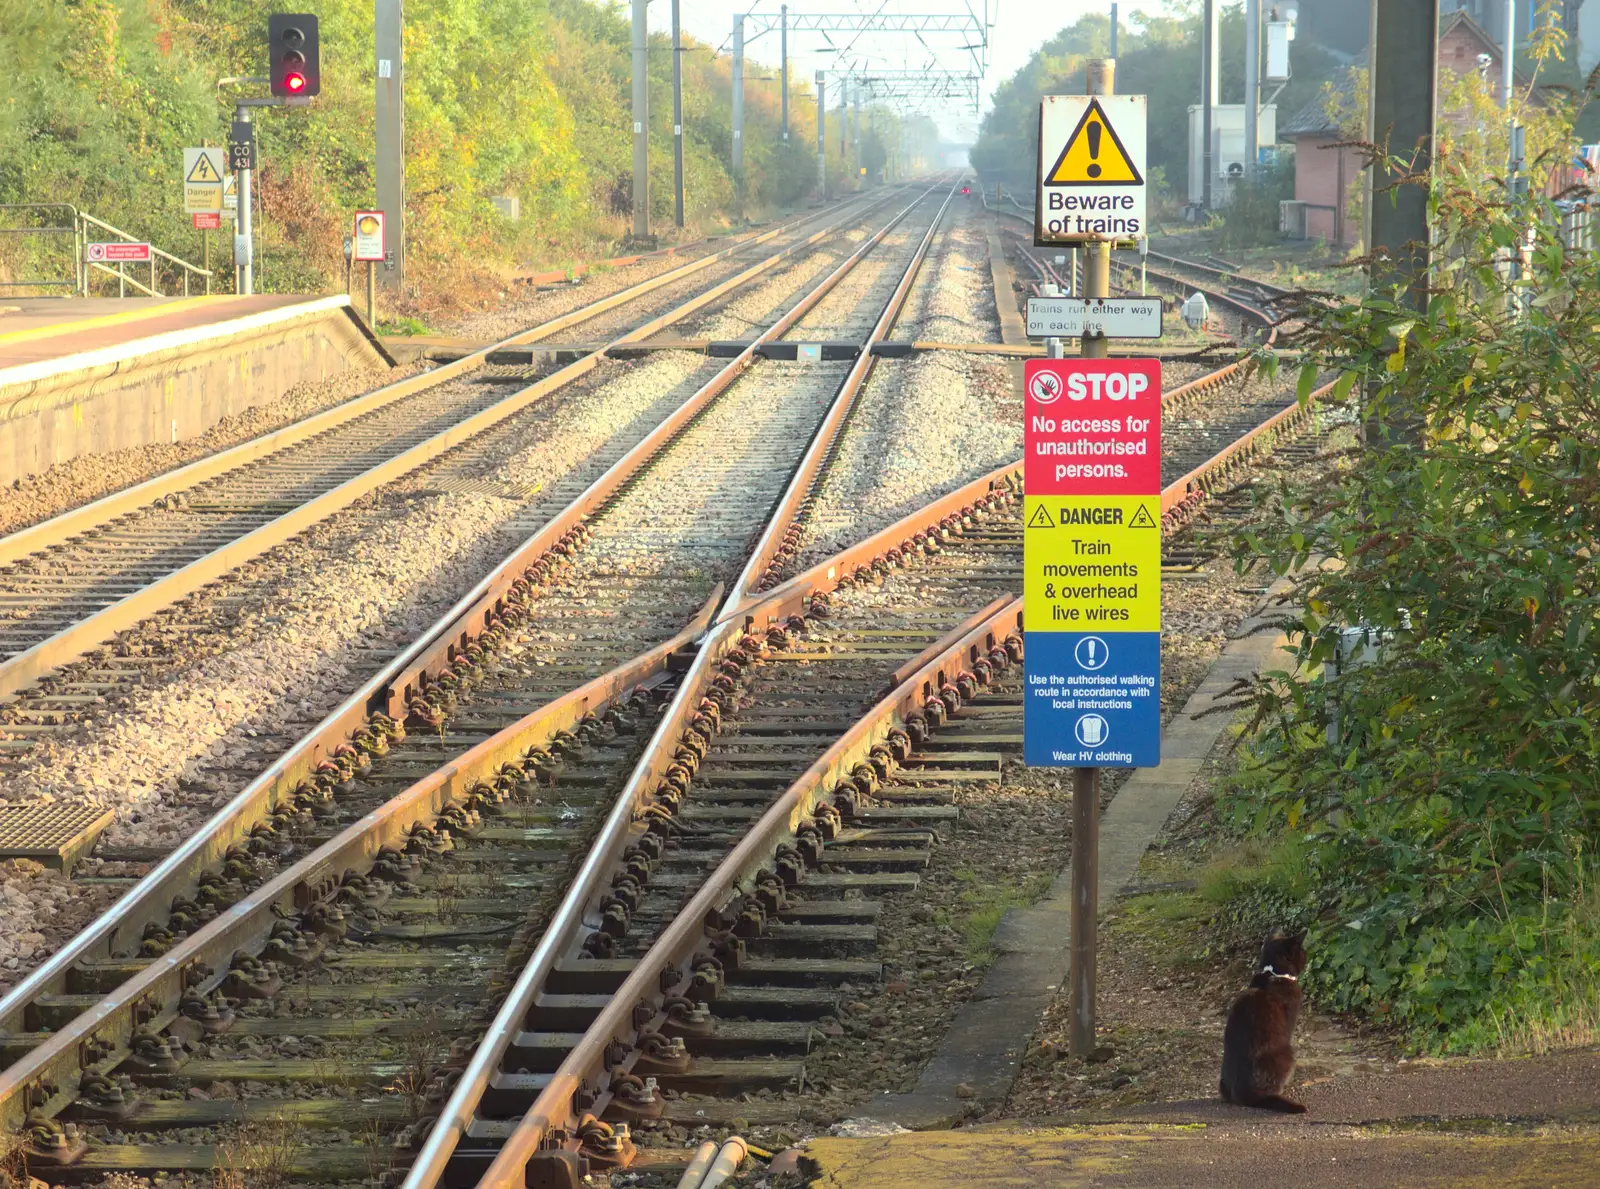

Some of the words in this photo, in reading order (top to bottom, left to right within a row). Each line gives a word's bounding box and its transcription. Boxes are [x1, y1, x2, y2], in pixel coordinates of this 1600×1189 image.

[234, 157, 250, 168] 431
[187, 188, 216, 196] Danger
[1049, 192, 1134, 210] Beware
[1048, 215, 1070, 233] of
[1076, 215, 1140, 233] trains
[1030, 304, 1062, 314] Trains
[1068, 305, 1087, 314] run
[1092, 303, 1126, 315] either
[1131, 306, 1153, 316] way
[1029, 321, 1044, 330] on
[1049, 320, 1077, 330] each
[1082, 319, 1102, 331] line
[1067, 372, 1149, 401] STOP
[1032, 416, 1056, 433] No
[1061, 419, 1121, 433] access
[1126, 415, 1150, 433] for
[1036, 438, 1147, 455] unauthorised
[1055, 464, 1128, 482] persons.
[1060, 508, 1123, 525] DANGER
[1071, 539, 1111, 555] Train
[1043, 562, 1138, 577] movements
[1044, 583, 1056, 599] &
[1061, 583, 1138, 599] overhead
[1052, 605, 1080, 621] live
[1085, 605, 1129, 621] wires
[1029, 675, 1047, 685] Use
[1049, 675, 1065, 685] the
[1067, 675, 1118, 685] authorised
[1119, 675, 1155, 687] walking
[1034, 687, 1060, 697] route
[1061, 687, 1070, 697] in
[1072, 687, 1128, 697] accordance
[1130, 687, 1150, 697] with
[1052, 699, 1075, 709] local
[1077, 699, 1132, 709] instructions
[1052, 751, 1077, 761] Wear
[1079, 751, 1093, 761] HV
[1095, 751, 1132, 763] clothing
